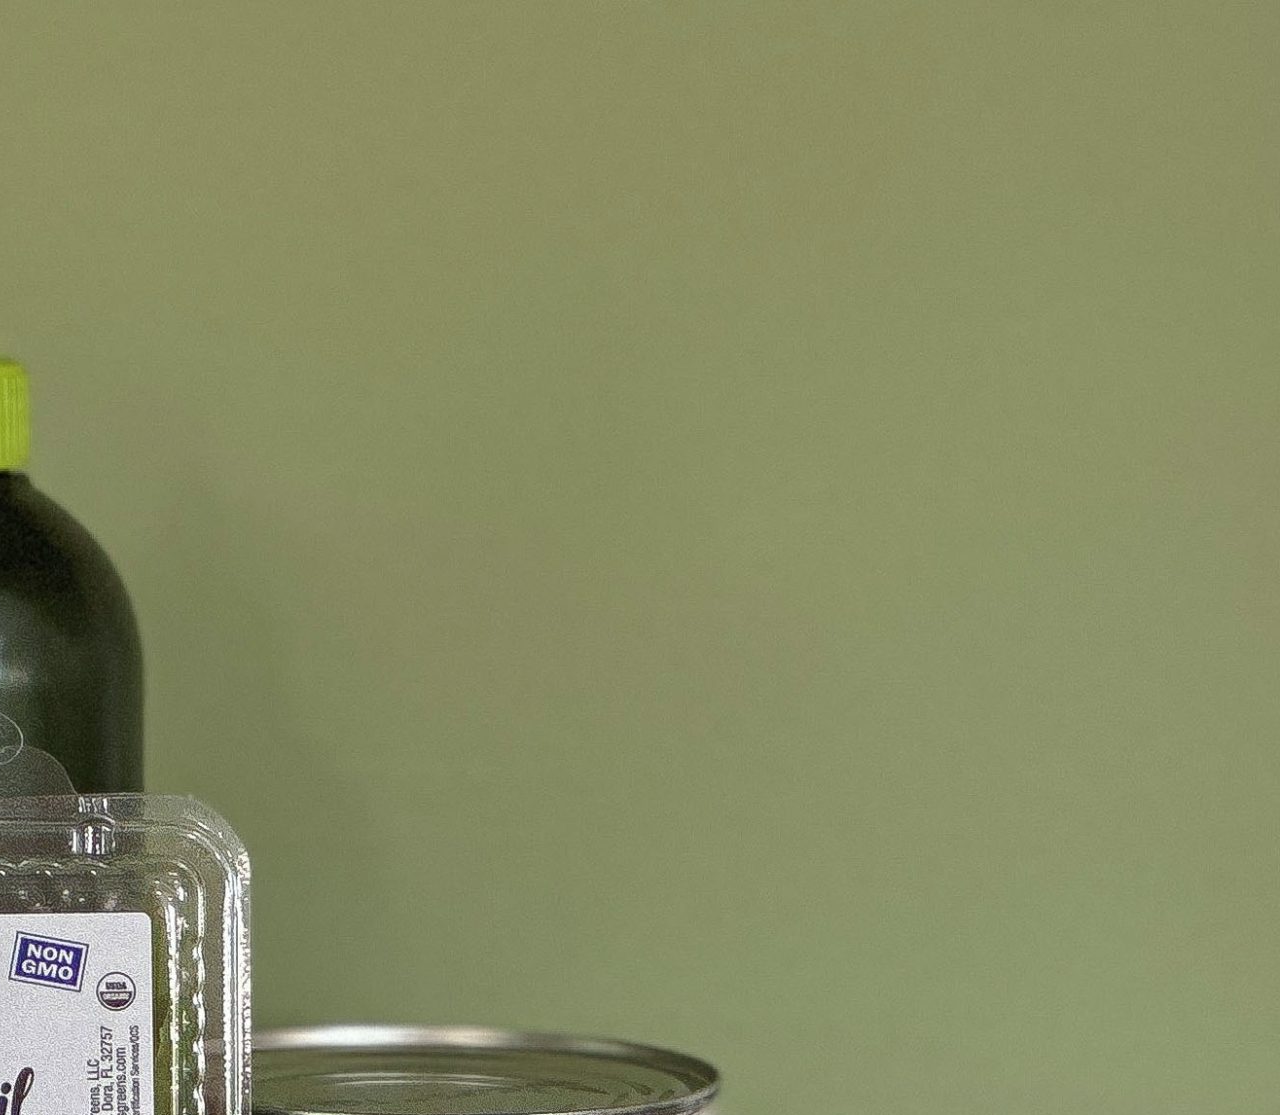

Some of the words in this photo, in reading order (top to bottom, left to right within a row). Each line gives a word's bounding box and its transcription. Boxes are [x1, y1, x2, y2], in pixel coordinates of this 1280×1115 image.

[27, 943, 74, 964] NON
[21, 959, 74, 980] GMO
[100, 1025, 113, 1062] 32757
[87, 1058, 100, 1081] LLC
[100, 1064, 114, 1079] FL
[101, 1081, 114, 1112] Dora,
